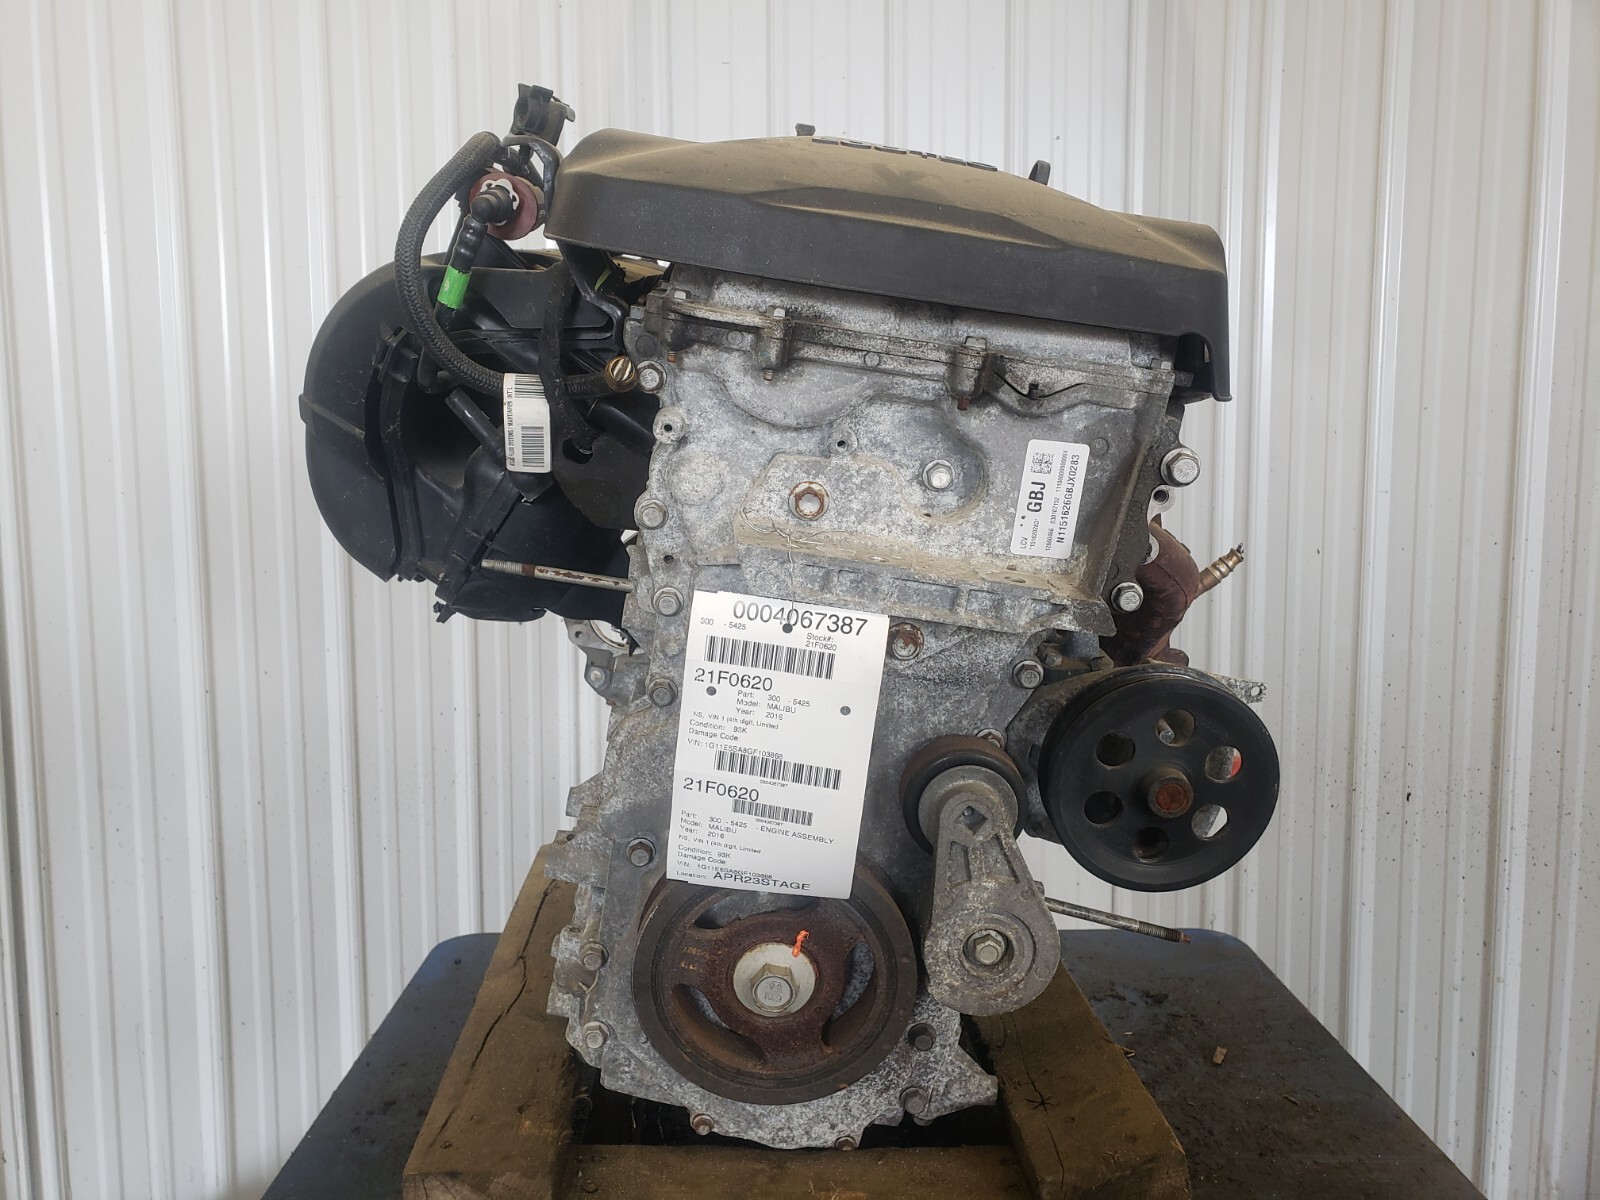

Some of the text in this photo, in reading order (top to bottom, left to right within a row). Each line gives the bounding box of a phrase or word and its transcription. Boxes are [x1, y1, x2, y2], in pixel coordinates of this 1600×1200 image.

[1026, 481, 1046, 513] GBJ
[1020, 536, 1028, 550] LCV
[733, 600, 868, 636] 0004067387
[728, 622, 747, 631] 5425
[806, 632, 834, 643] Stock#:
[805, 640, 838, 652] 21F0620
[694, 667, 773, 692] 21F0620
[736, 698, 797, 714] Model: MALIBU
[737, 690, 755, 699] Part:
[767, 694, 781, 703] 300
[792, 698, 811, 708] 5425
[736, 707, 784, 721] Year: 2016
[689, 718, 726, 730] Condition:
[756, 720, 779, 730] Limited
[688, 727, 718, 739] Damage
[687, 738, 703, 747] VIN:
[683, 777, 760, 802] 21F0620
[680, 817, 738, 834] Model: MALIBU
[680, 810, 698, 819] Part:
[708, 816, 722, 824] 300
[730, 820, 748, 828] 5425
[760, 826, 790, 837] ENGINE
[792, 832, 834, 845] ASSEMBLY
[680, 824, 725, 840] Year: 2016
[678, 844, 712, 856] Condition:
[676, 860, 692, 868] VIN:
[677, 851, 728, 865] Damage Code:
[676, 870, 812, 892] Location: APR23STAGE
